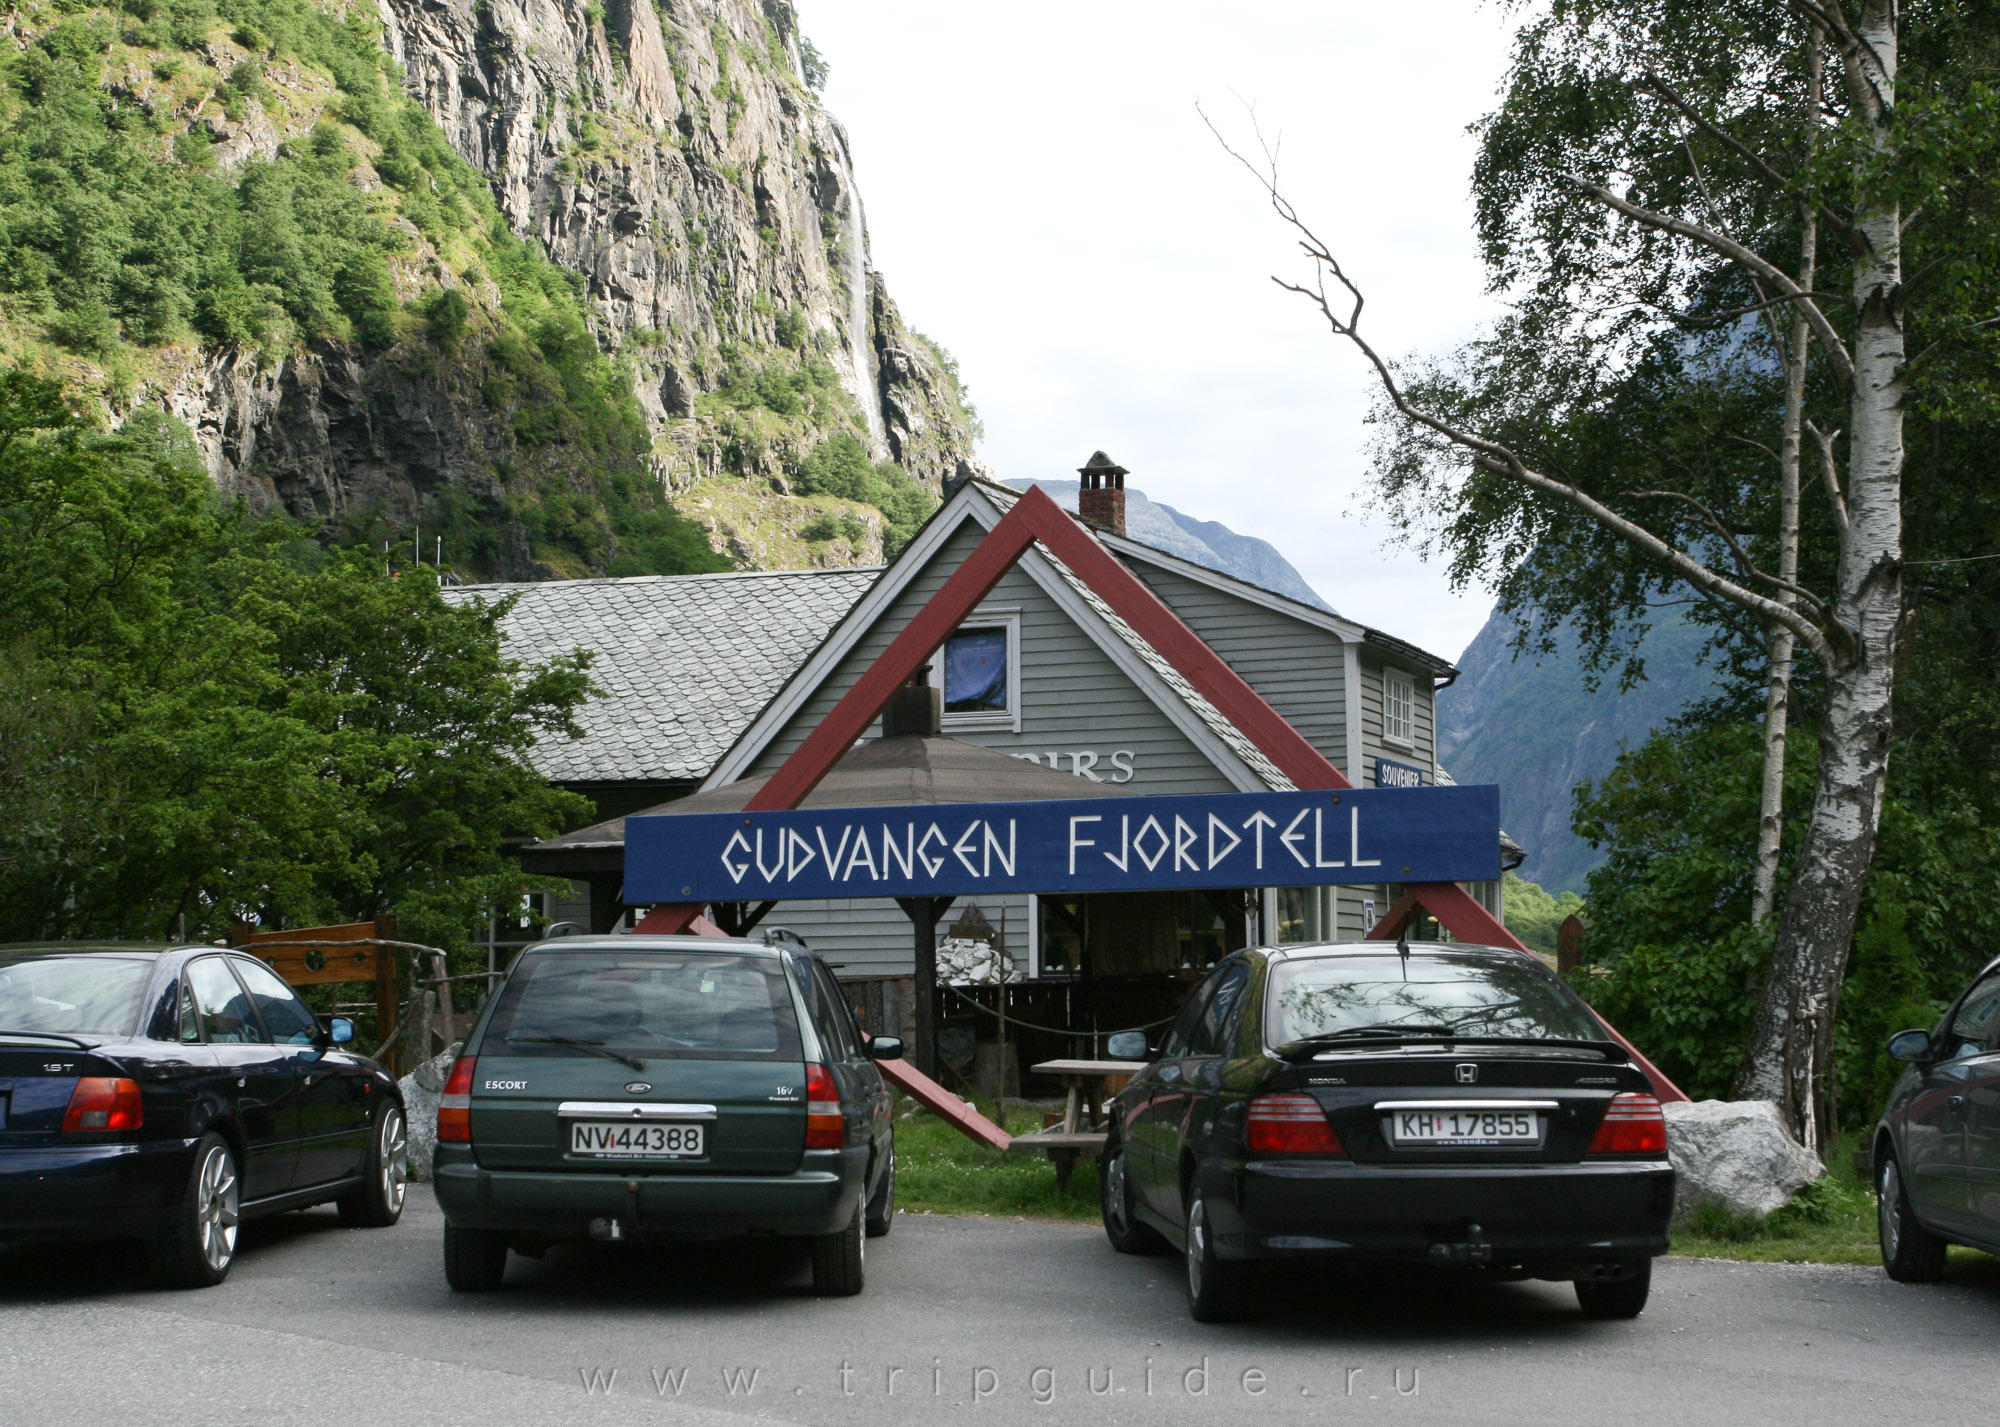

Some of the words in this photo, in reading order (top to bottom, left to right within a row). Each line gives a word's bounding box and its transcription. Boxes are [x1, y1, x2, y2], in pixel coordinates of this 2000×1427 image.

[720, 818, 1016, 884] GUDVANGEN
[1069, 806, 1381, 875] FJORDTELL
[485, 1080, 528, 1090] ESCORT
[1402, 1114, 1434, 1136] KH
[1449, 1114, 1530, 1136] 17855
[575, 1127, 611, 1149] NV
[616, 1128, 699, 1151] 44388
